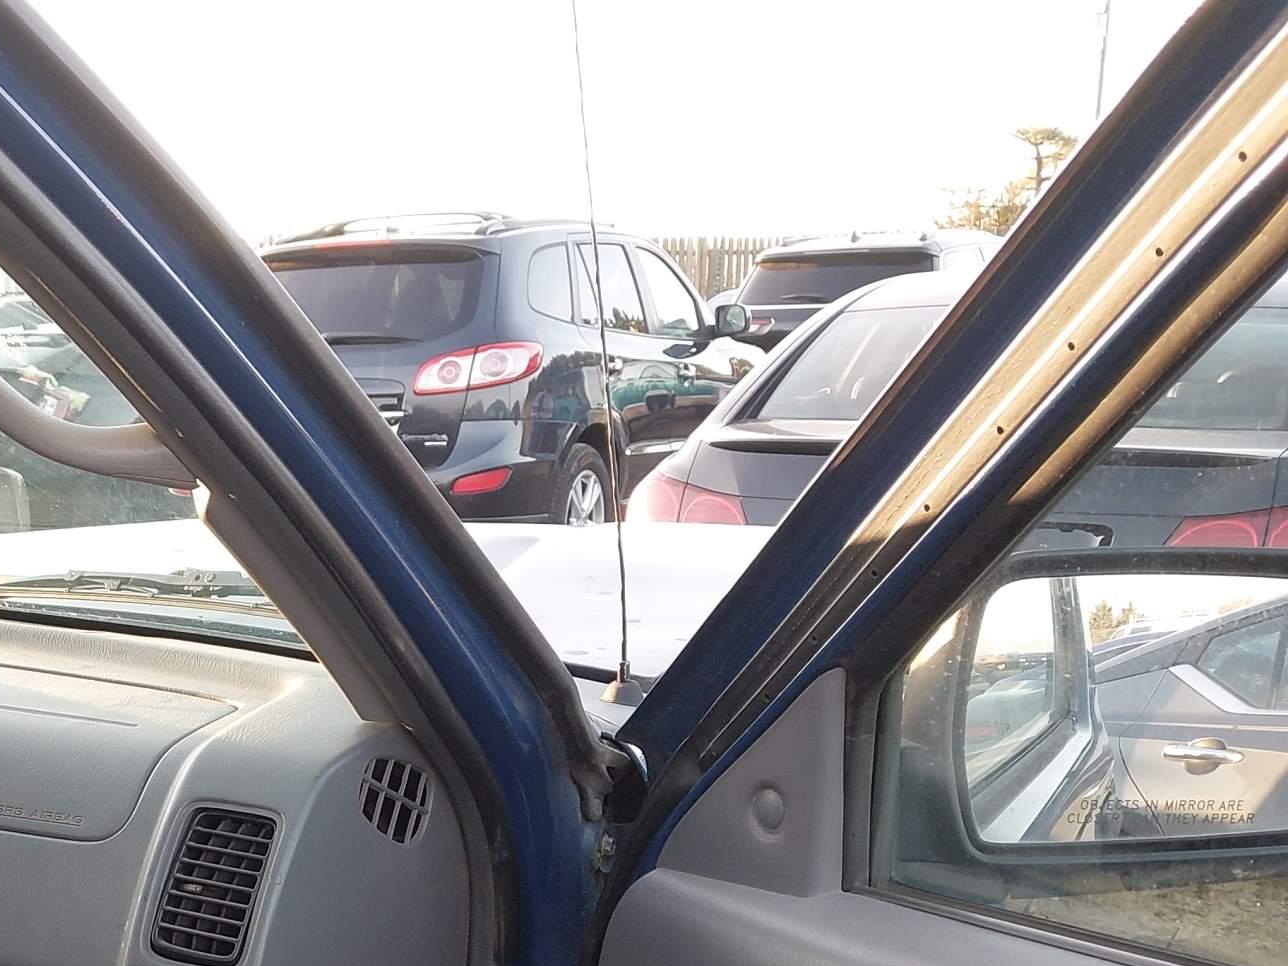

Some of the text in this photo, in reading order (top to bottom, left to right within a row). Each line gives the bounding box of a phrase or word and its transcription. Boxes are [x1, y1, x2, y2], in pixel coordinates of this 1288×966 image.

[1164, 799, 1214, 811] MIRROR
[1218, 799, 1244, 811] ARE
[29, 808, 85, 824] AIRBAG
[1165, 812, 1198, 824] THEY
[1201, 812, 1256, 824] APPEAR
